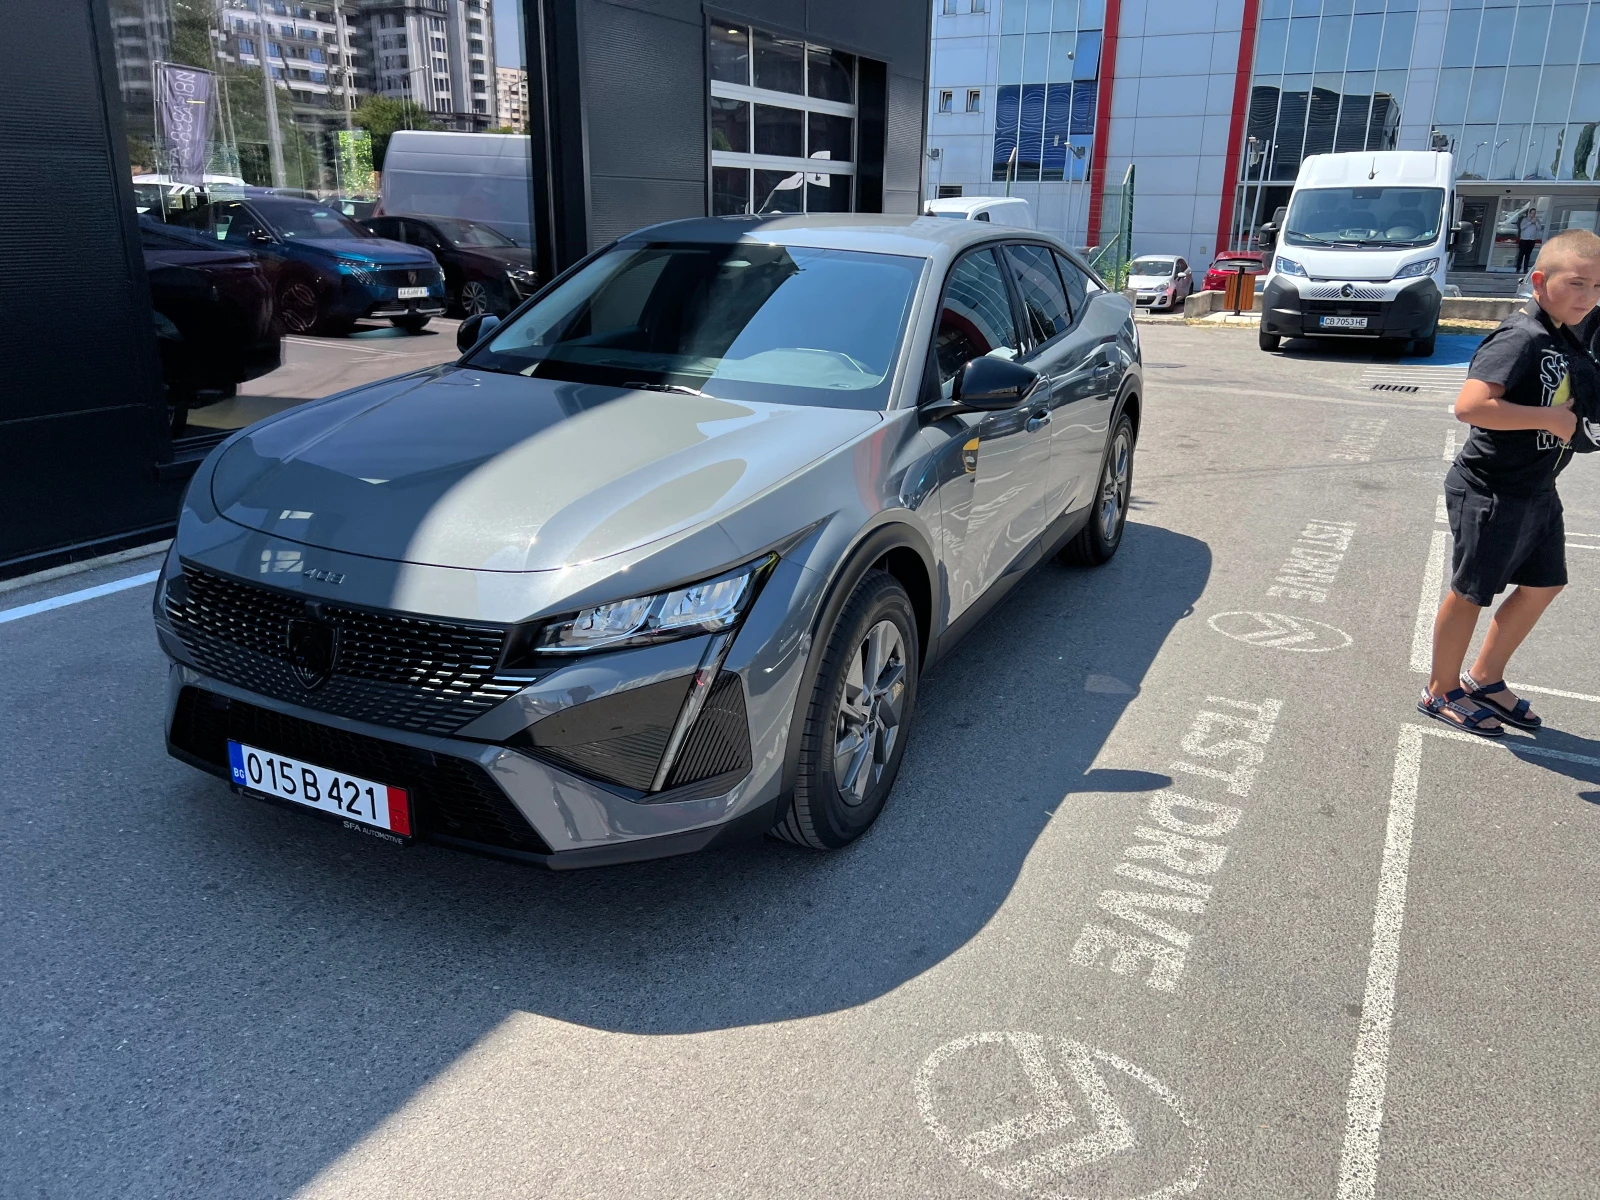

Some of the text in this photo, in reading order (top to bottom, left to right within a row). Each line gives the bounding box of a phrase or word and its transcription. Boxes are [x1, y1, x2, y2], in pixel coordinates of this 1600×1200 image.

[1324, 317, 1366, 327] CB 7053 HE
[304, 568, 345, 584] 408
[233, 767, 245, 779] BG
[343, 820, 403, 845] SFA AUTOMOTIVE
[1068, 695, 1283, 993] TEST DRIVE
